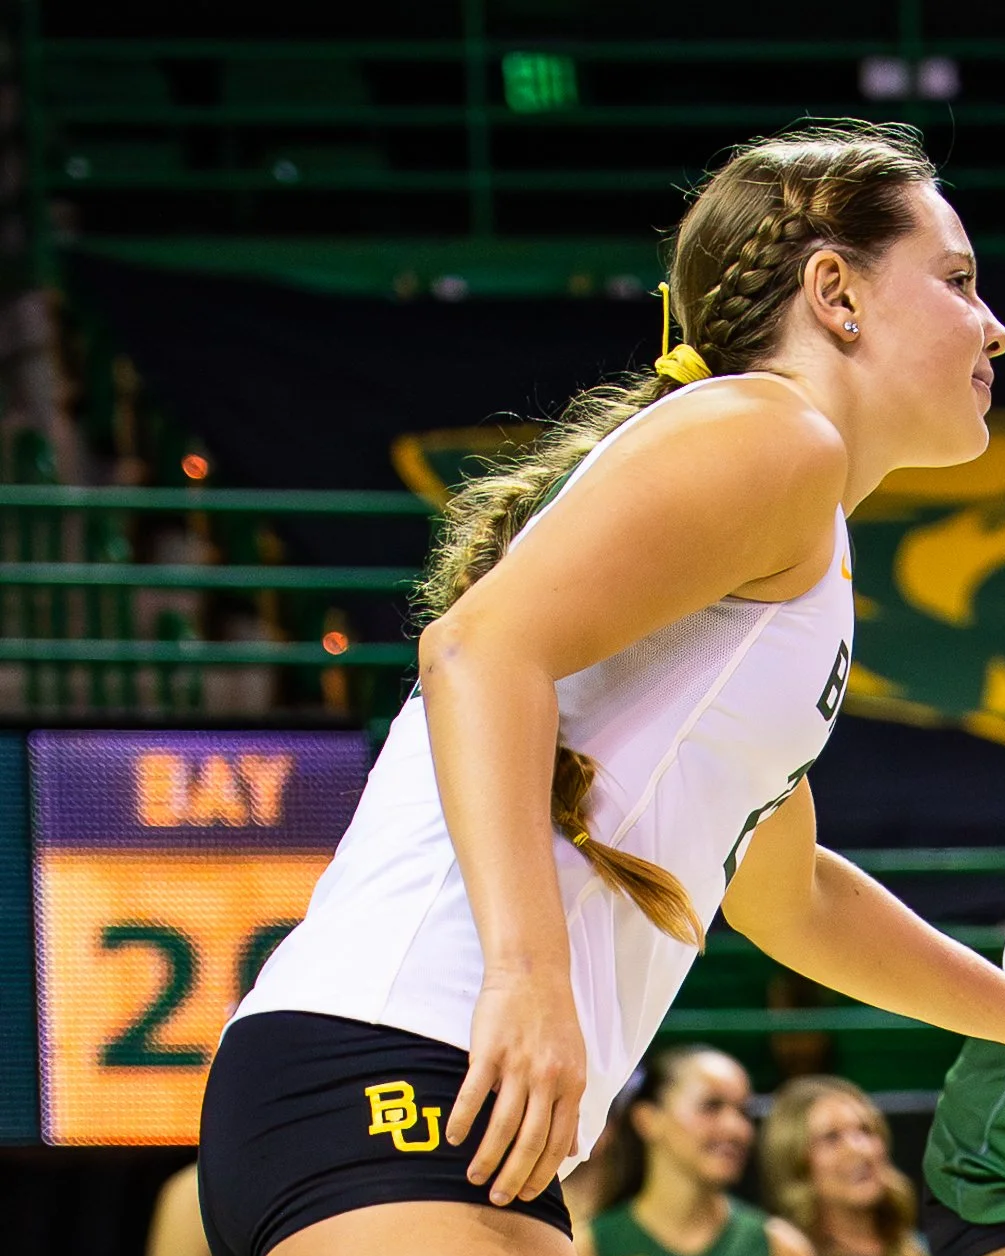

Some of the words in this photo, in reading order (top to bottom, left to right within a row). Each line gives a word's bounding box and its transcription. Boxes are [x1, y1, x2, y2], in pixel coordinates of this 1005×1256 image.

[816, 639, 849, 733] B
[137, 750, 296, 827] BAY
[364, 1080, 441, 1152] BU
